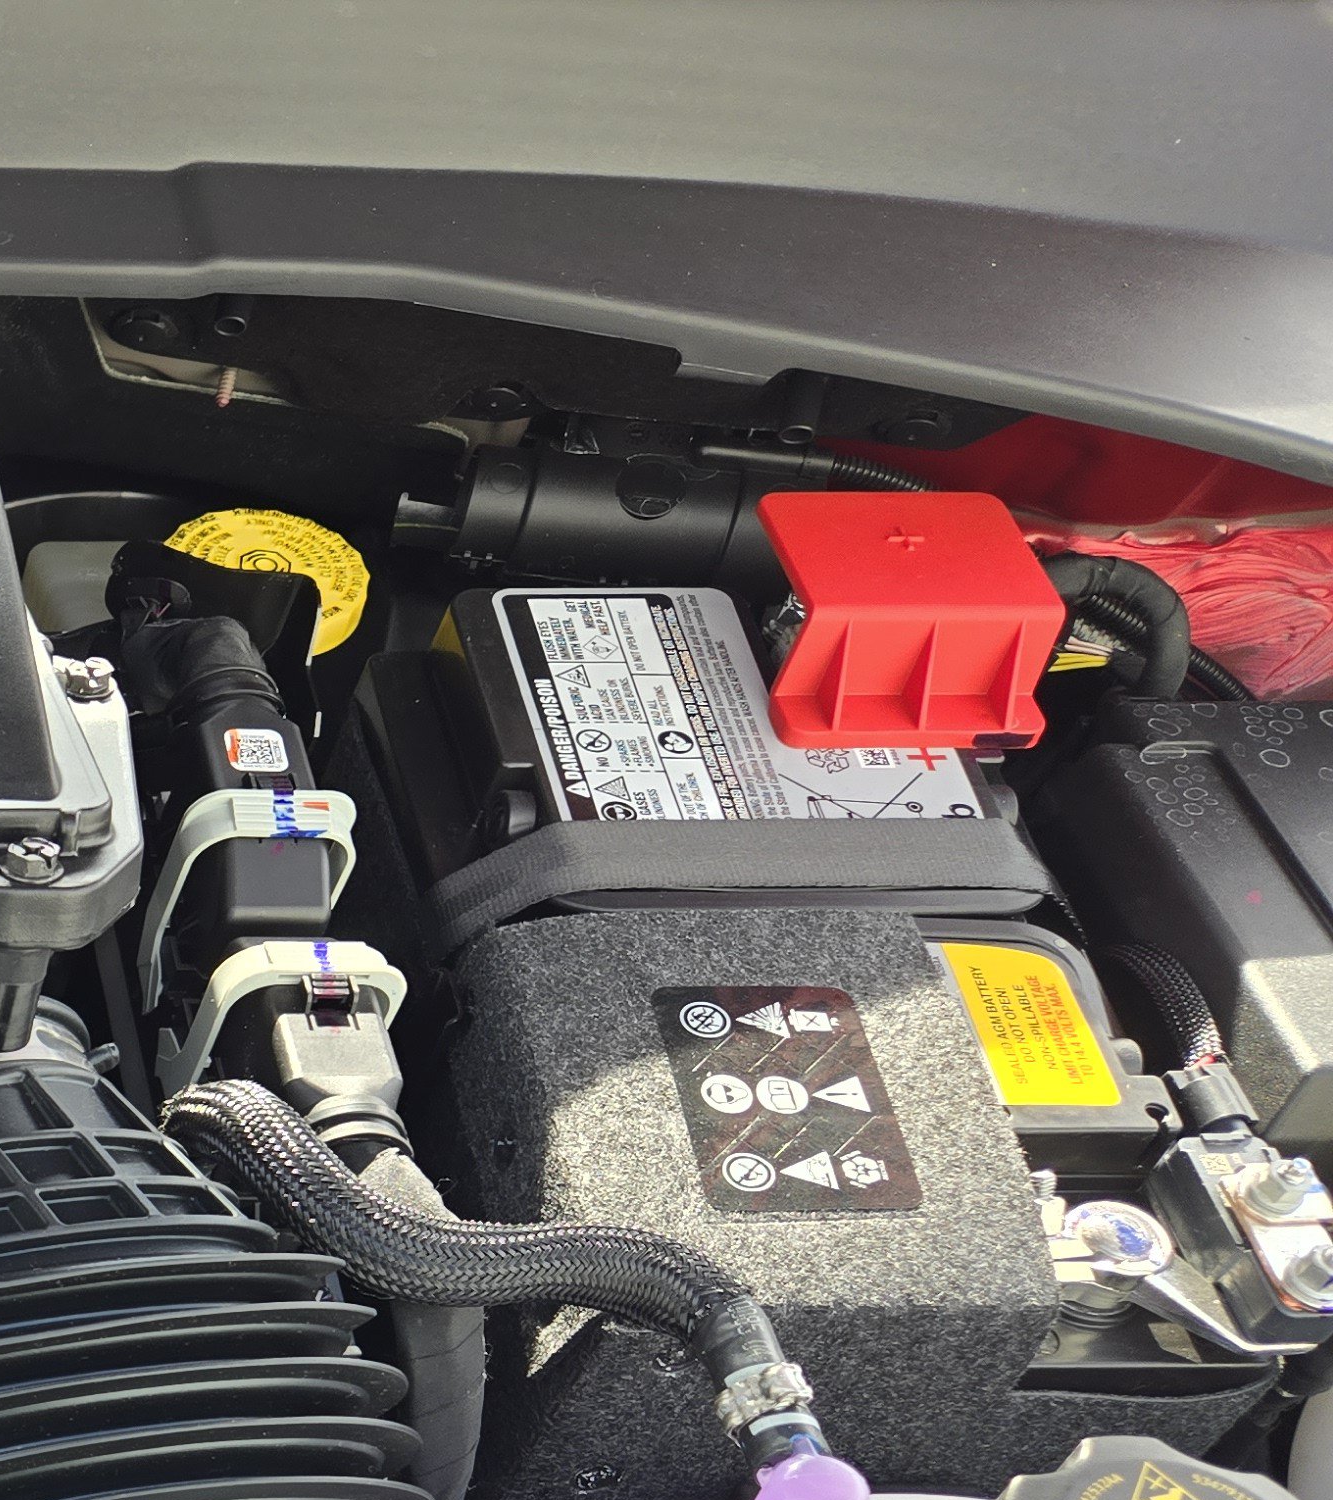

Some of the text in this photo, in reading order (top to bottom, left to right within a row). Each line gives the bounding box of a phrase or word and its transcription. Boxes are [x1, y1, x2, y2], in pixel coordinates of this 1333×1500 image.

[564, 600, 577, 613] GET
[577, 600, 596, 629] MEDICAL
[595, 618, 611, 636] HELP
[537, 620, 559, 660] FLUSH EYES
[548, 616, 572, 660] IMMEDIATELY
[625, 635, 639, 651] OPEN
[569, 643, 584, 660] WITH
[630, 651, 643, 663] NOT
[634, 662, 646, 672] DO
[567, 686, 589, 720] SULFURIC
[597, 688, 617, 720] CAN CAUSE
[606, 679, 631, 720] BLINDNESS OR
[588, 704, 604, 720] ACID
[626, 699, 643, 721] SEVERE
[651, 710, 664, 727] READ
[533, 678, 583, 780] DANGER/POISON
[596, 756, 610, 767] NO
[676, 782, 688, 793] THE
[633, 791, 652, 816] GASES
[680, 794, 692, 803] OF
[695, 802, 707, 811] OF
[684, 802, 696, 815] OUT
[968, 965, 1028, 1085] SEALED AGM BATTERY
[994, 987, 1036, 1063] DO NOT OPEN!
[1012, 984, 1059, 1070] NON-SPILLABLE
[1025, 975, 1084, 1085] LIMIT CHARGE VOLTAGE
[1055, 1010, 1076, 1041] VOLTS
[1073, 1042, 1089, 1061] 14.4
[1081, 1065, 1096, 1076] TO
